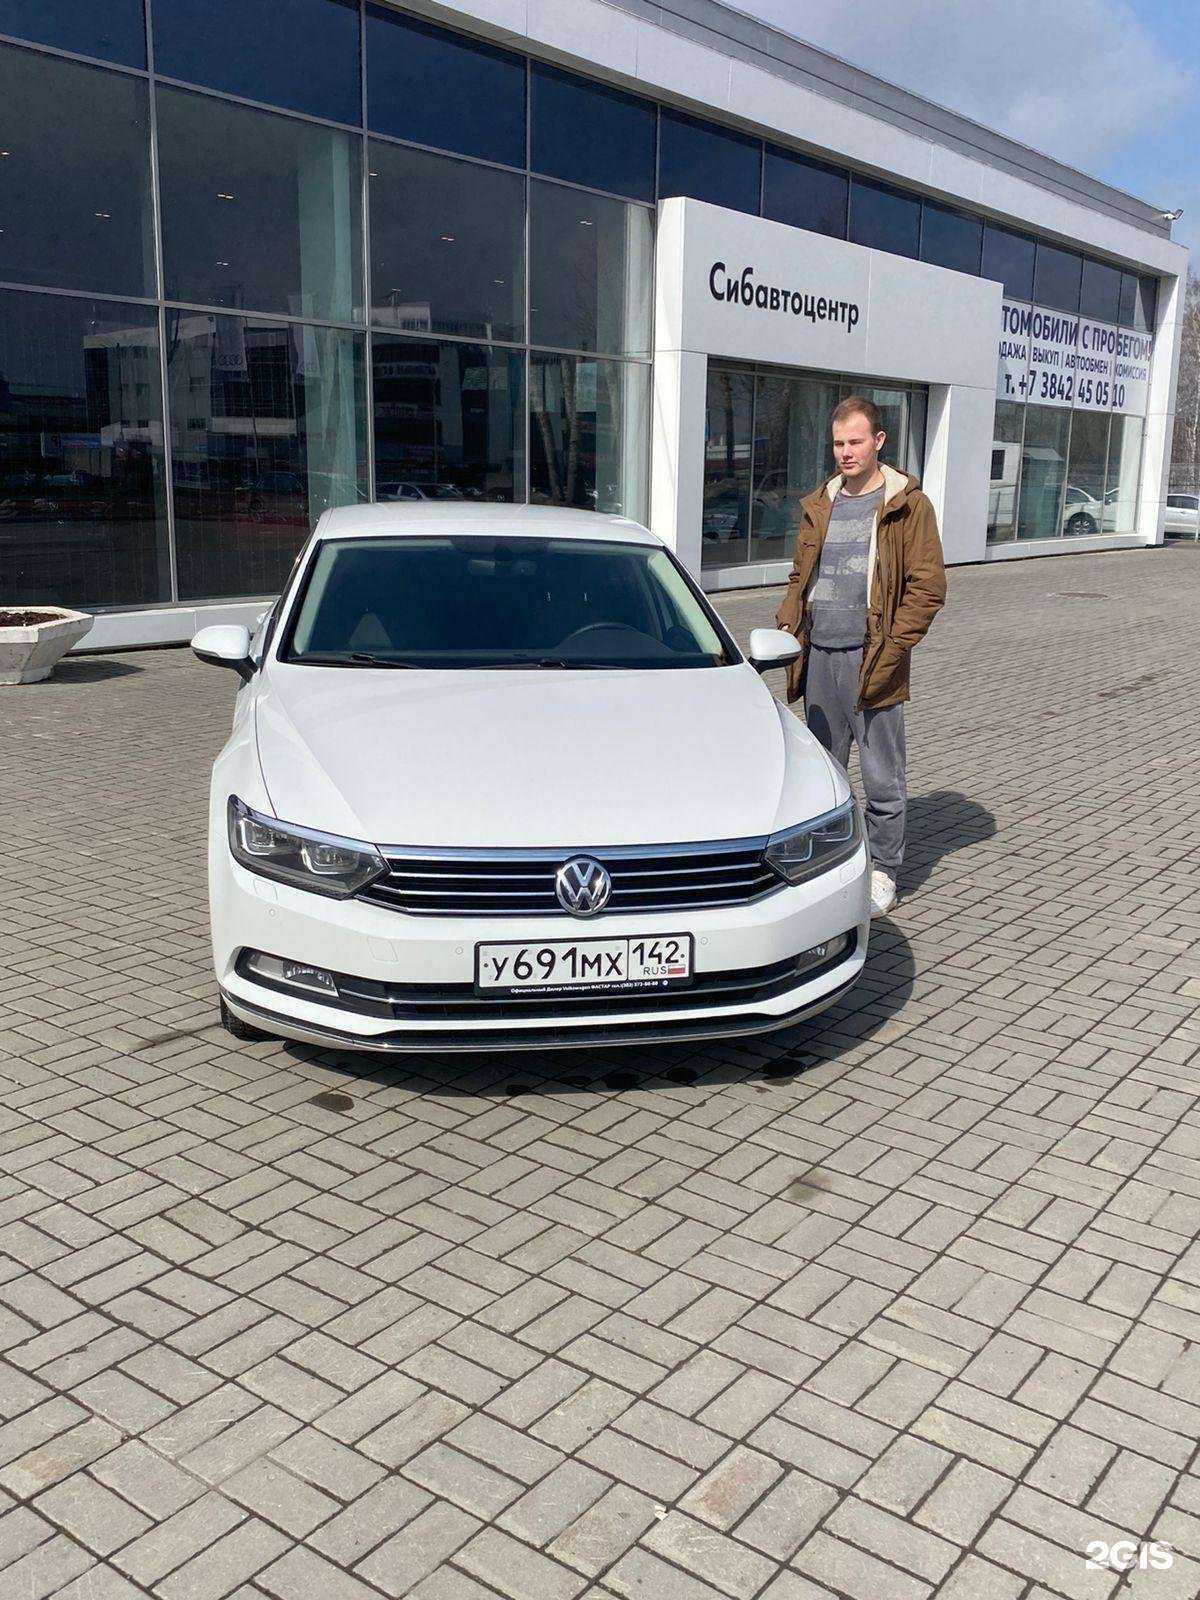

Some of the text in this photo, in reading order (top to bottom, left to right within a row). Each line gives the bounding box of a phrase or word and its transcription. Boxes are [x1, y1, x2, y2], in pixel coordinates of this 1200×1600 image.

[709, 261, 859, 333] Сибавтоцентр
[1082, 325, 1091, 349] С
[999, 341, 1147, 381] ДАЖА ВЫКУП АВТООБМЕН КОМИССИЯ
[1018, 370, 1037, 396] +7
[1041, 371, 1073, 401] 3842
[1078, 378, 1092, 404] 45
[1095, 380, 1109, 405] 05
[1112, 384, 1125, 407] 10
[491, 947, 623, 981] У691МХ
[632, 940, 680, 966] 142
[643, 965, 667, 976] RUS
